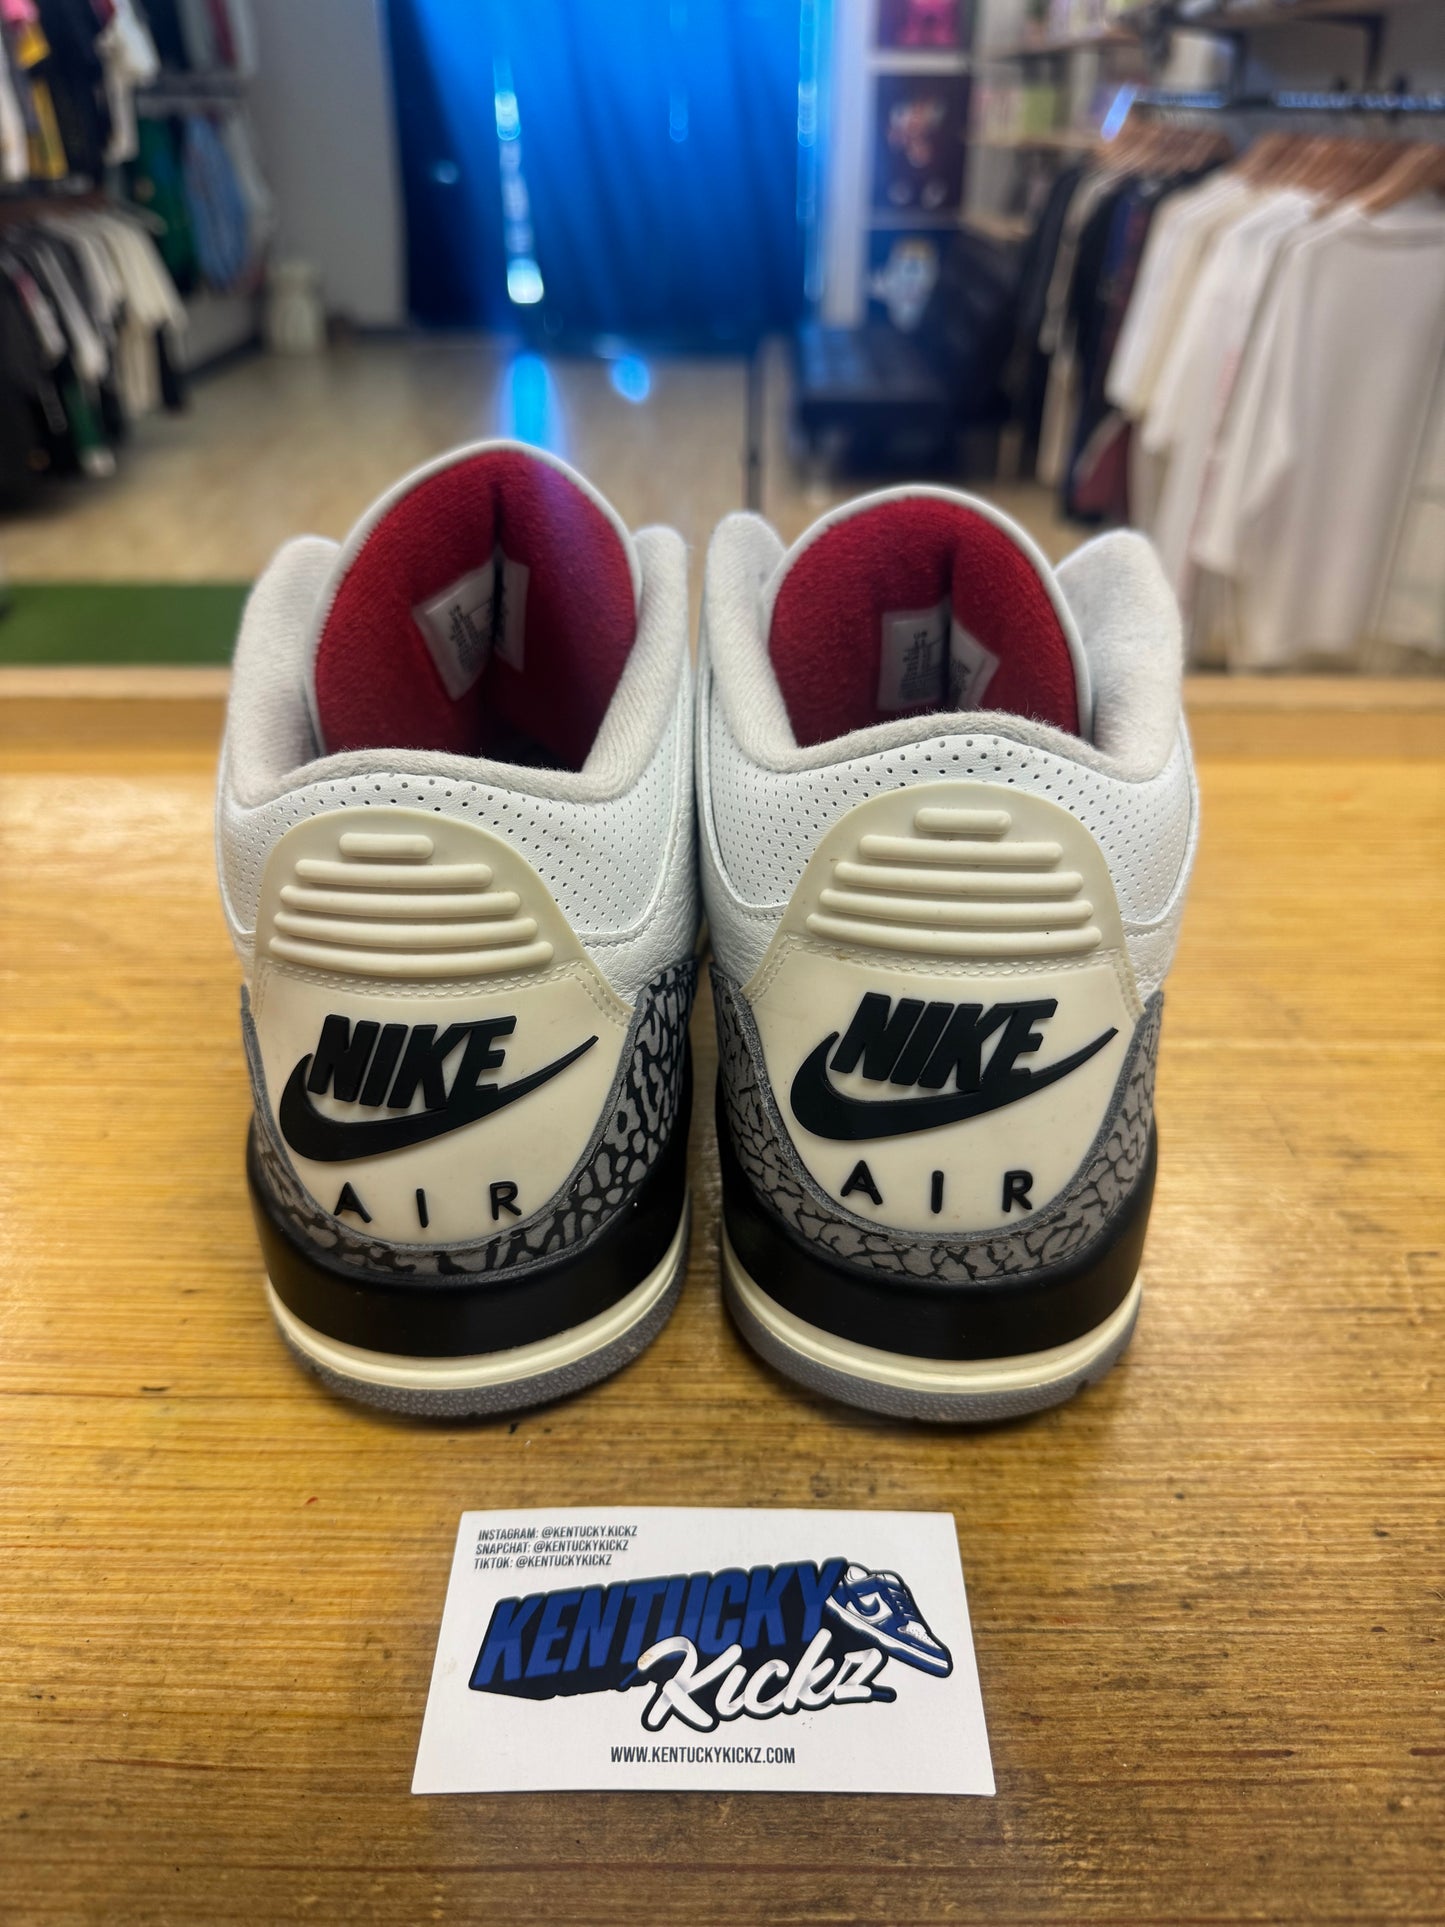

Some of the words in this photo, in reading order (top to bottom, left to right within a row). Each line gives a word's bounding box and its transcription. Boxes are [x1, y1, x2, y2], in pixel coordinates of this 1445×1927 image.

[307, 1014, 517, 1109] NIKE
[829, 991, 1058, 1090] NIKE
[334, 1181, 523, 1228] AIR
[840, 1160, 1034, 1214] AIR
[476, 1542, 530, 1555] SNAPCHAT:
[533, 1539, 629, 1554] @KENTUCKYKICKZ
[478, 1528, 538, 1541] INSTAGRAM:
[541, 1525, 638, 1539] @KENTUCKY.KICKZ
[474, 1557, 513, 1569] TIKTOK:
[516, 1554, 612, 1569] @KENTUCKYKICKZ
[473, 1559, 845, 1687] KENTUCKY
[638, 1627, 883, 1728] Kickz
[610, 1746, 796, 1764] WWW.KENTUCKYKICKZ.COM
